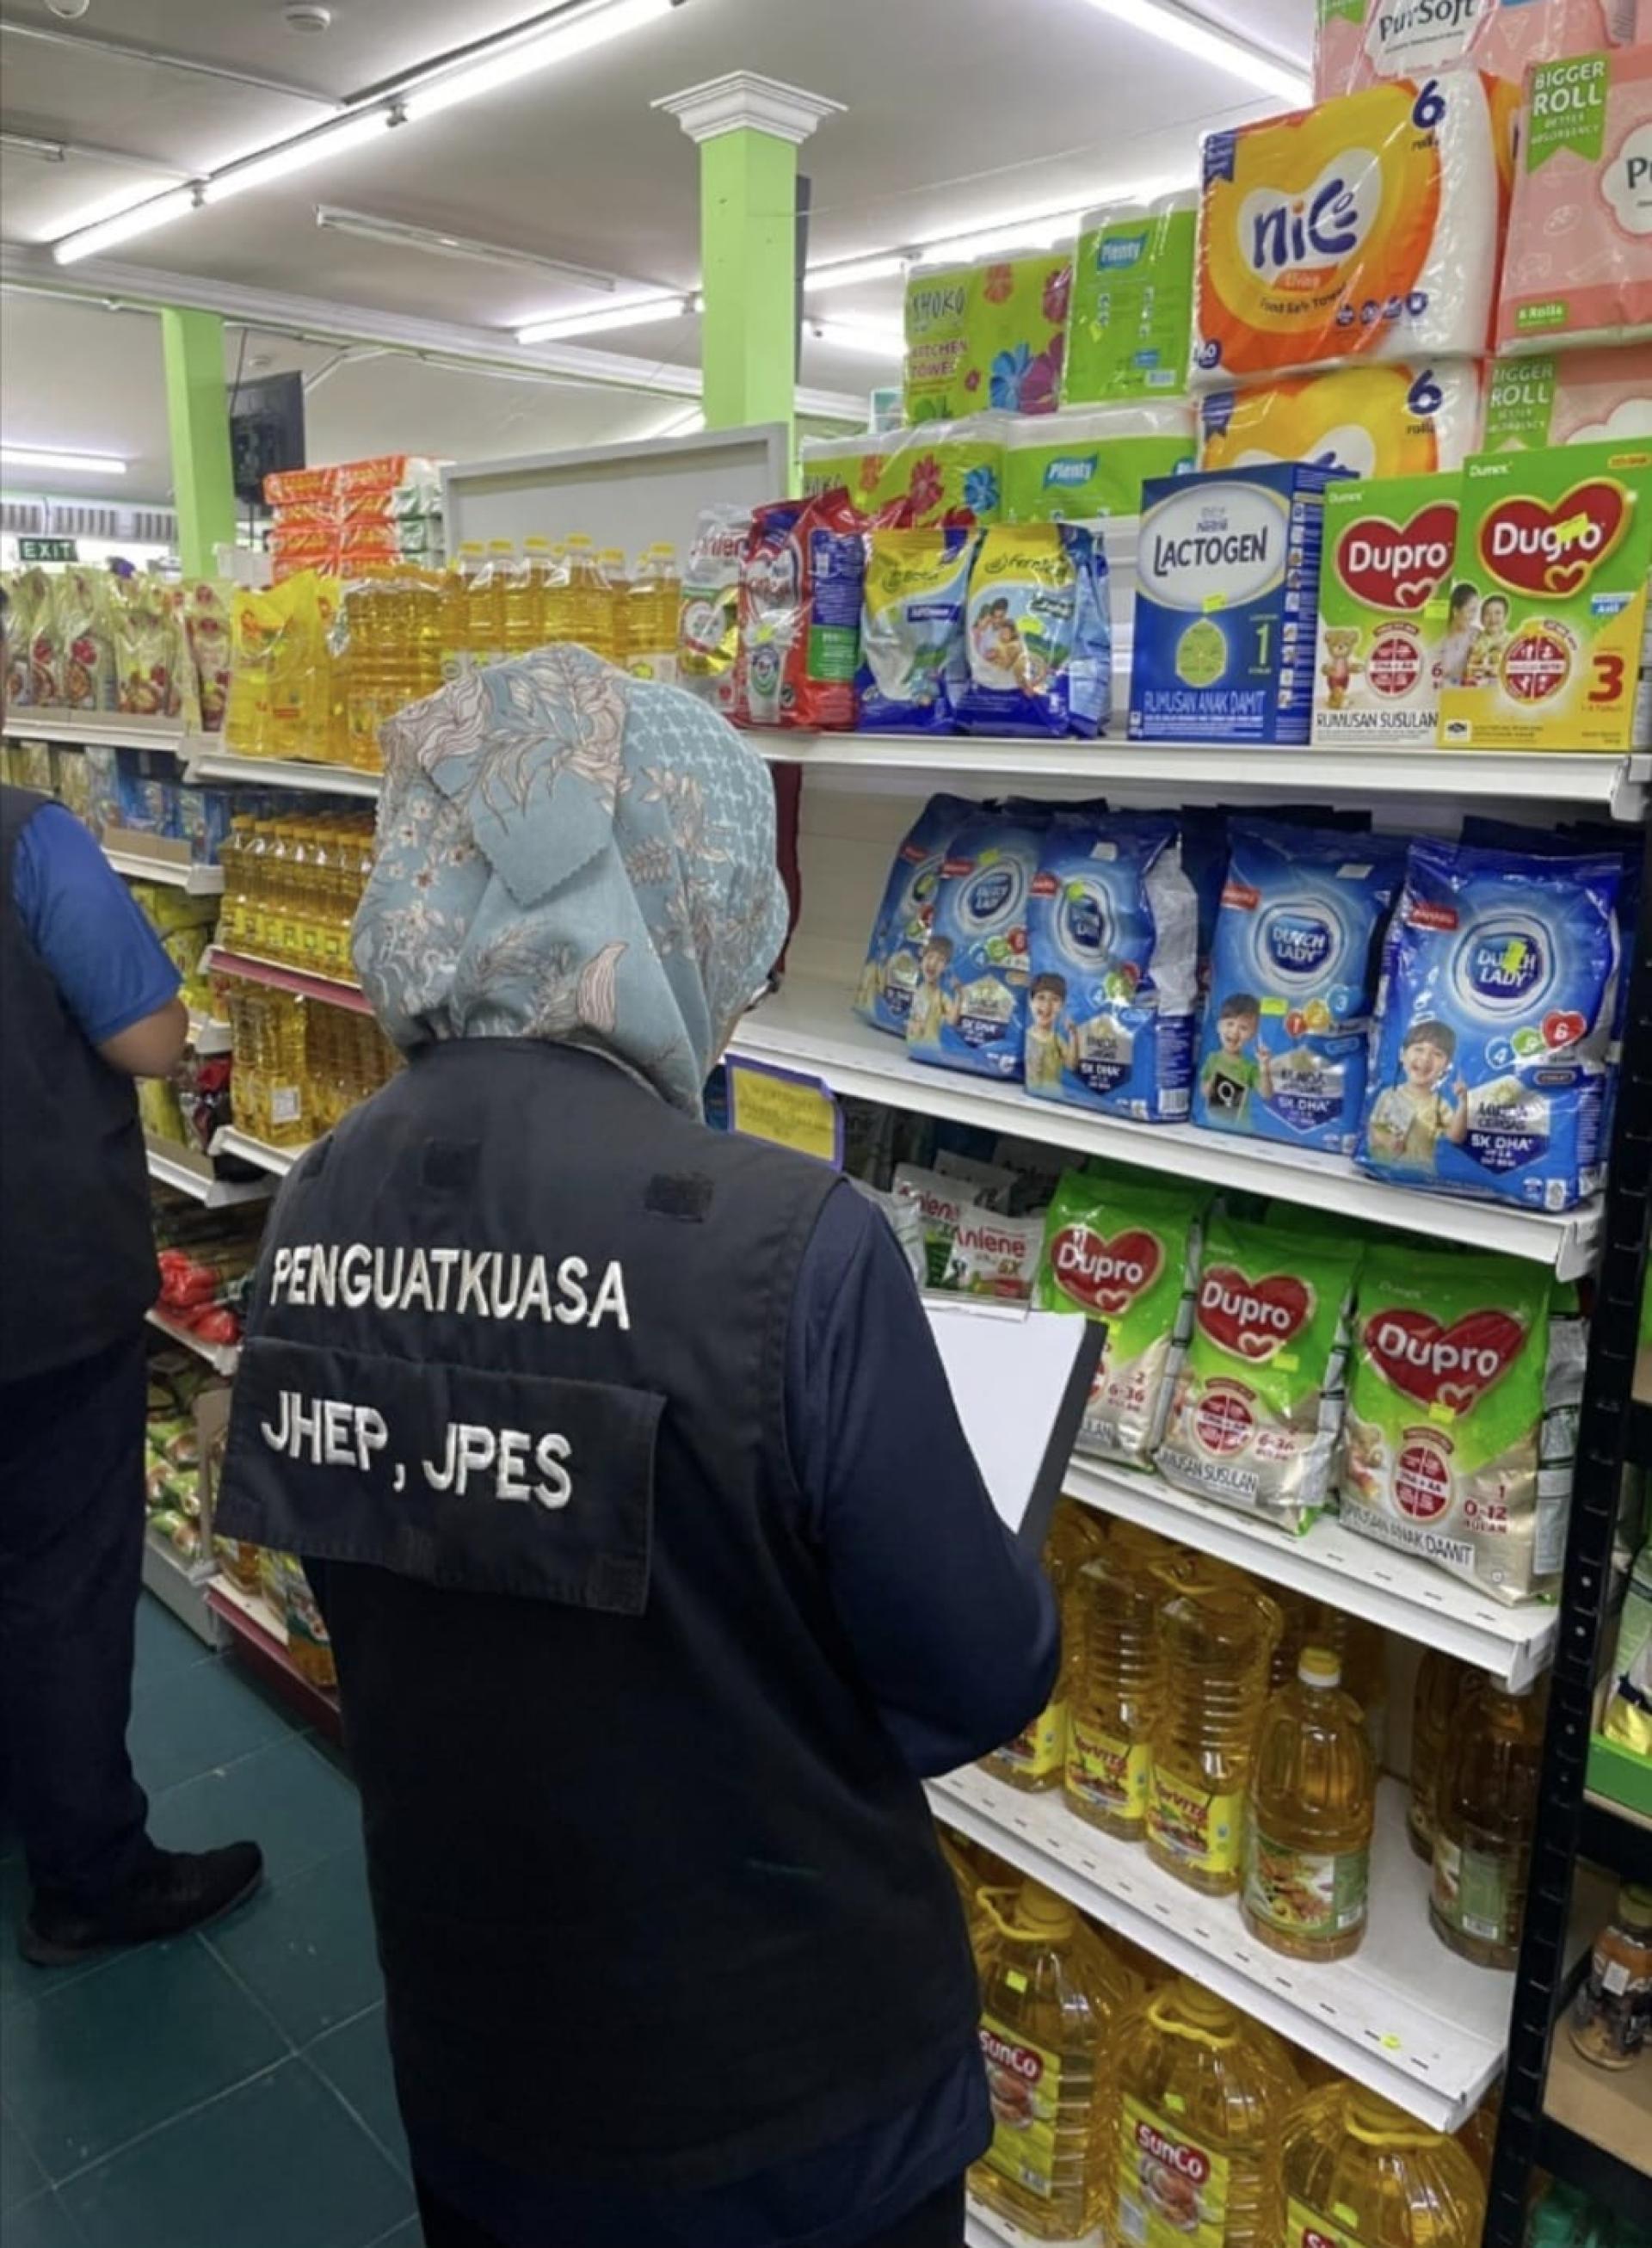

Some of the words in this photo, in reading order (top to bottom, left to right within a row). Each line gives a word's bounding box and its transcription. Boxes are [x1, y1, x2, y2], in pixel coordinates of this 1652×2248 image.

[1535, 61, 1605, 90] BIGGER
[1413, 78, 1446, 128] 6
[1533, 83, 1603, 116] ROLL
[1408, 369, 1442, 415] 6
[1490, 384, 1550, 408] ROLL
[25, 542, 71, 558] EXIT
[1154, 525, 1267, 576] LACTOGEN
[1348, 541, 1447, 578] Dupro
[1588, 655, 1624, 702] 3
[1316, 712, 1376, 728] RUMUSAN
[1379, 711, 1439, 728] SUSULAN
[1277, 943, 1315, 963] LADY
[1477, 948, 1537, 971] DUH
[1479, 966, 1525, 987] LADY
[1057, 1241, 1143, 1284] Dupro
[270, 1242, 631, 1331] PENGUATKUASA
[1200, 1280, 1291, 1329] Dupro
[1378, 1323, 1500, 1377] Dupro
[423, 1422, 573, 1509] JPES
[1205, 1463, 1256, 1494] SUSULAN
[1464, 1499, 1508, 1522] 0-12
[1424, 1534, 1473, 1566] DAMIT
[978, 2029, 1038, 2079] SunCo
[1138, 2122, 1204, 2180] SunCo
